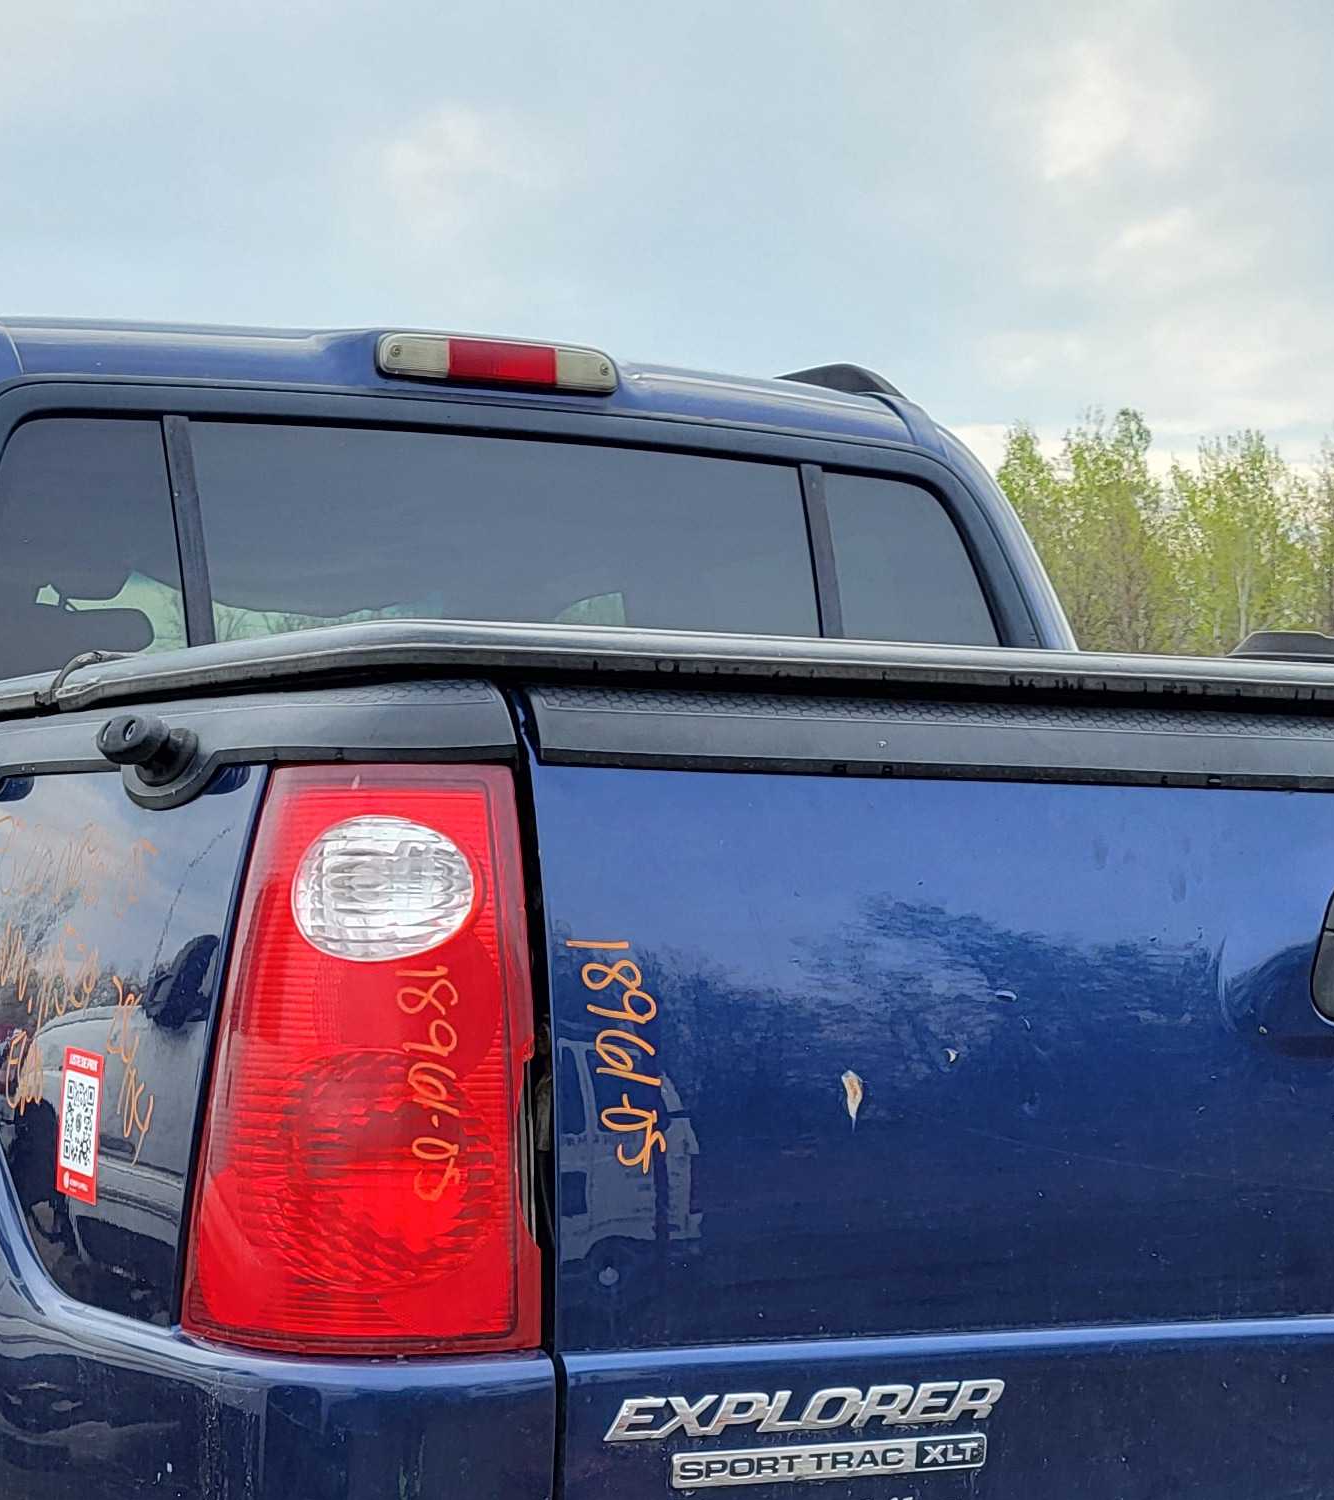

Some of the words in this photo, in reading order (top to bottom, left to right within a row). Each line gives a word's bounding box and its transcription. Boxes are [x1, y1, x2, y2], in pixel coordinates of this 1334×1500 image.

[395, 965, 461, 1201] 18961-05
[566, 940, 666, 1175] 18961-05
[603, 1378, 1005, 1442] EXPLORER
[678, 1454, 801, 1482] SPORT
[808, 1447, 905, 1474] TRAC
[922, 1442, 979, 1465] XLT
